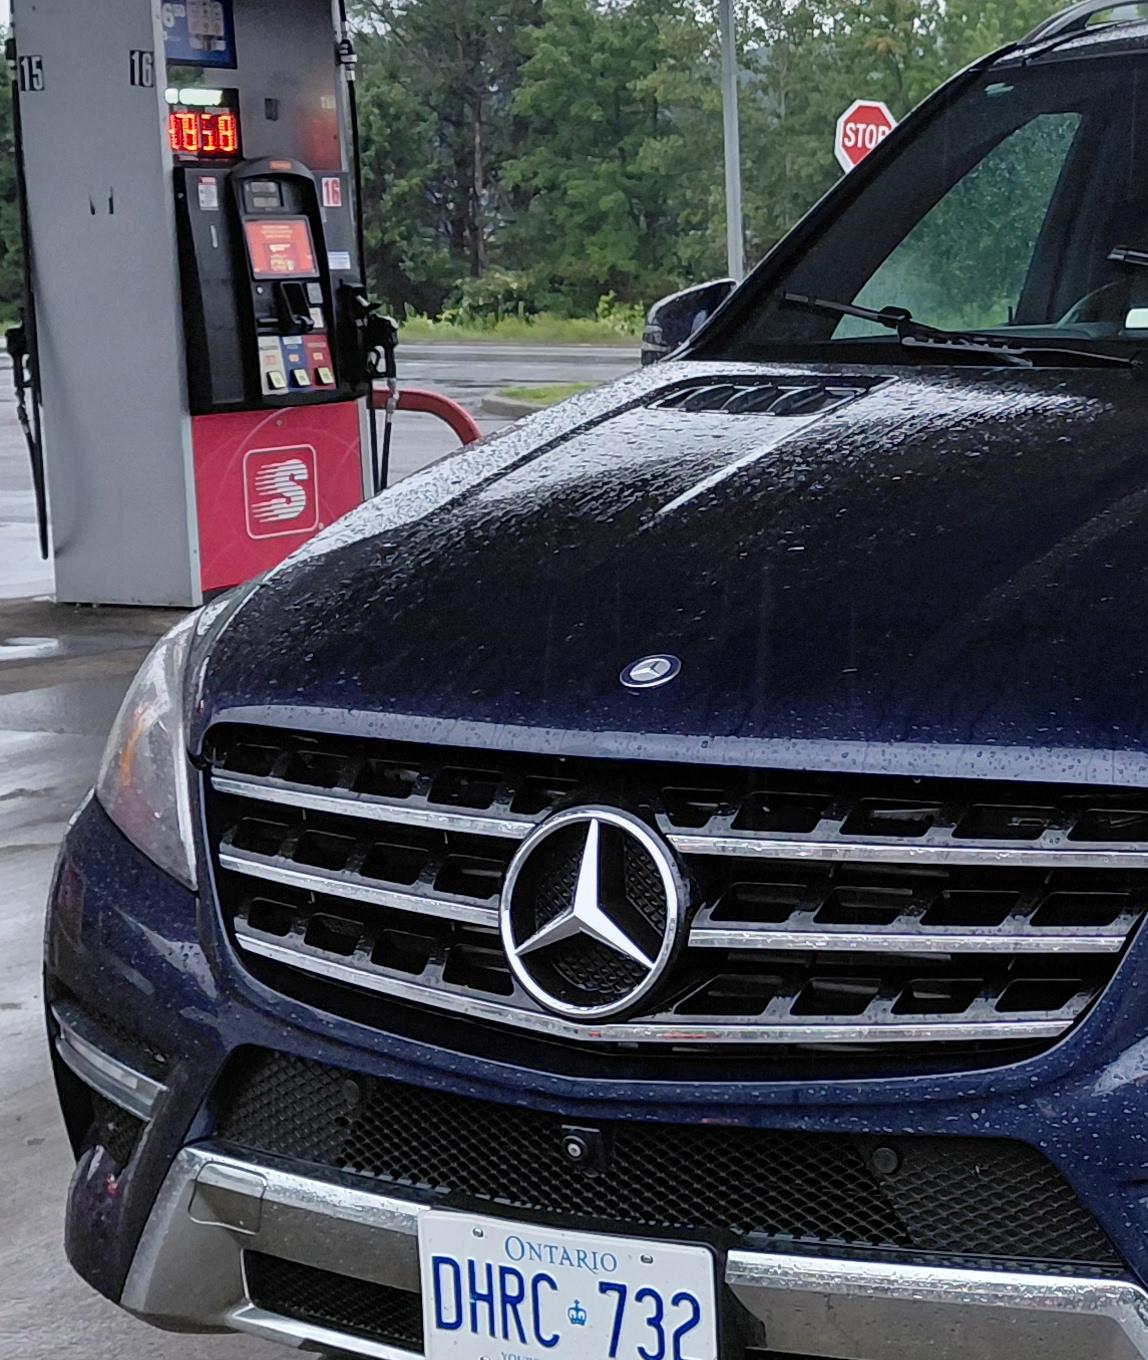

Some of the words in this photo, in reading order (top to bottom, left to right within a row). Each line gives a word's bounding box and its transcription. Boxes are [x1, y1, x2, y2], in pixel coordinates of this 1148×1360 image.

[21, 56, 43, 90] 15
[131, 51, 153, 87] 16
[843, 122, 890, 149] STOP
[324, 179, 341, 206] 16
[504, 1235, 618, 1275] ONTARIO
[431, 1255, 560, 1349] DHRC
